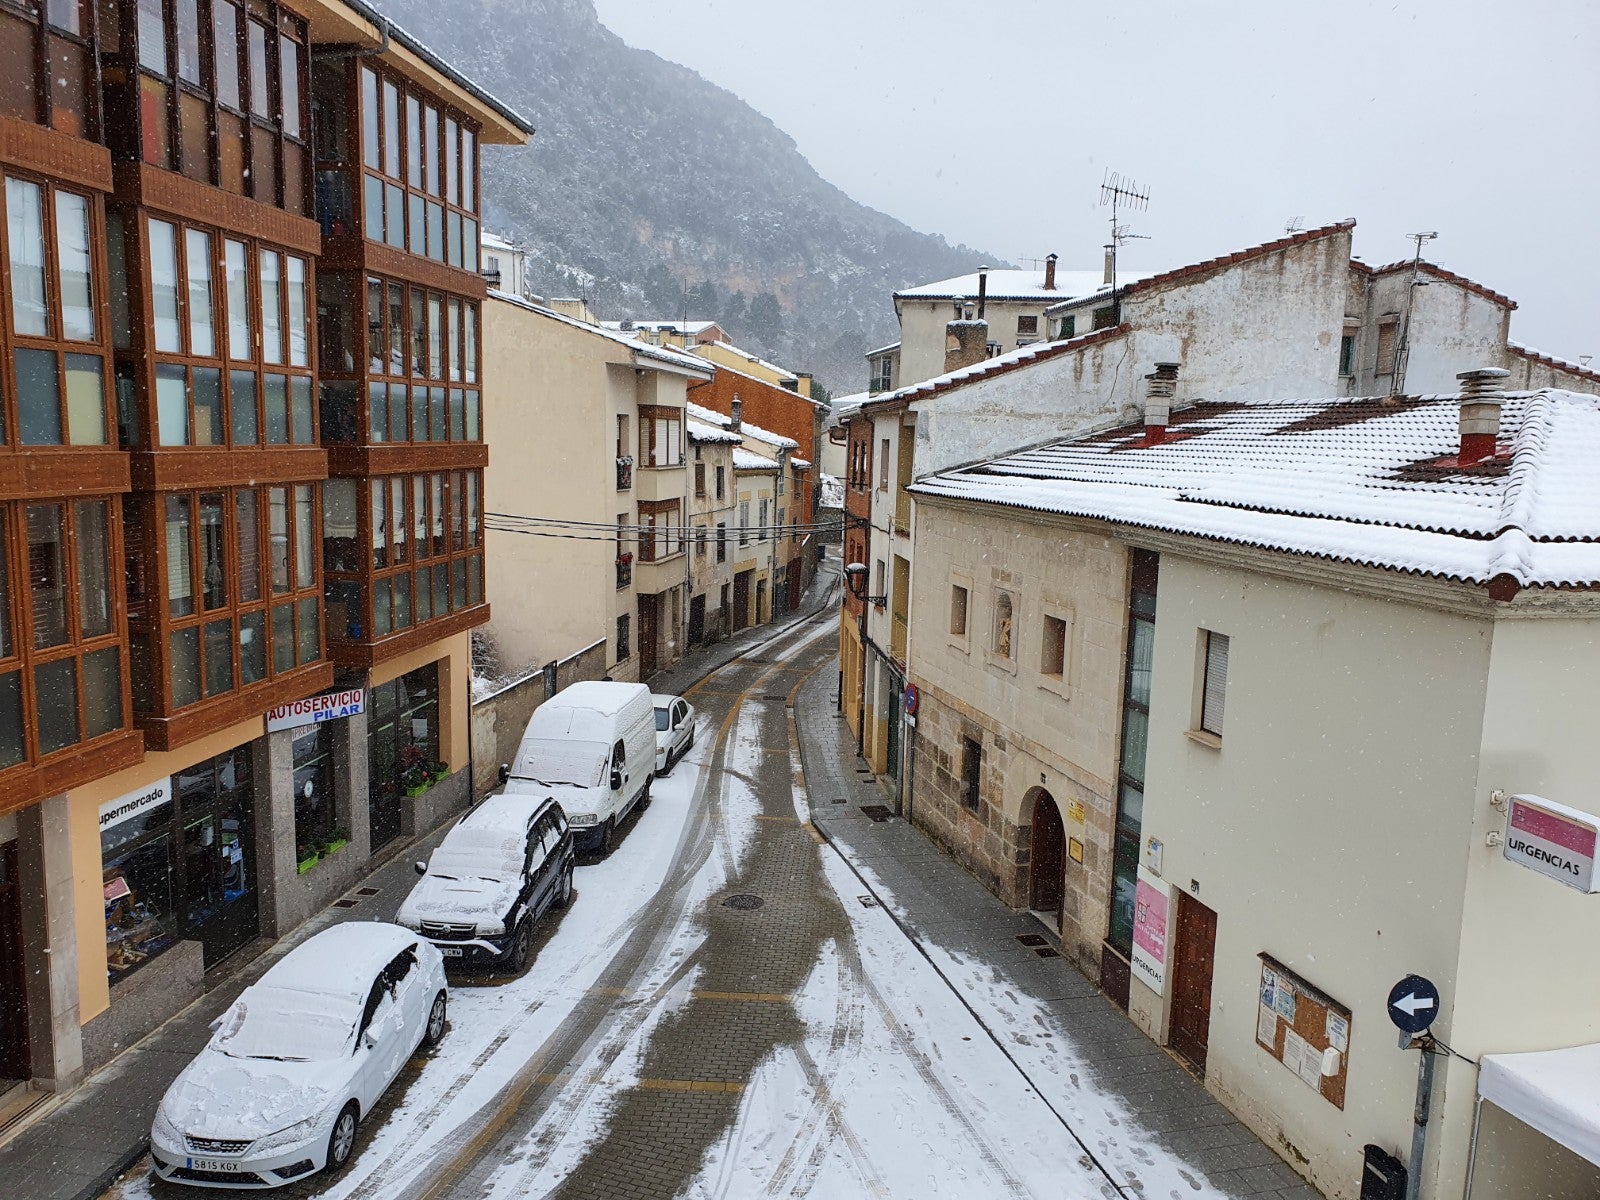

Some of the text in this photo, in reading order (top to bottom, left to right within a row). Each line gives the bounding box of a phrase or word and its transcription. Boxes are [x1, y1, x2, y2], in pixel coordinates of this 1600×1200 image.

[268, 690, 361, 721] AUTOSERVICIO
[313, 704, 360, 722] PILAR
[99, 788, 163, 825] upermercado
[1508, 837, 1580, 876] URGENCIAS
[1131, 953, 1162, 983] URGENCIAS
[194, 1160, 238, 1171] 5815 KGX
